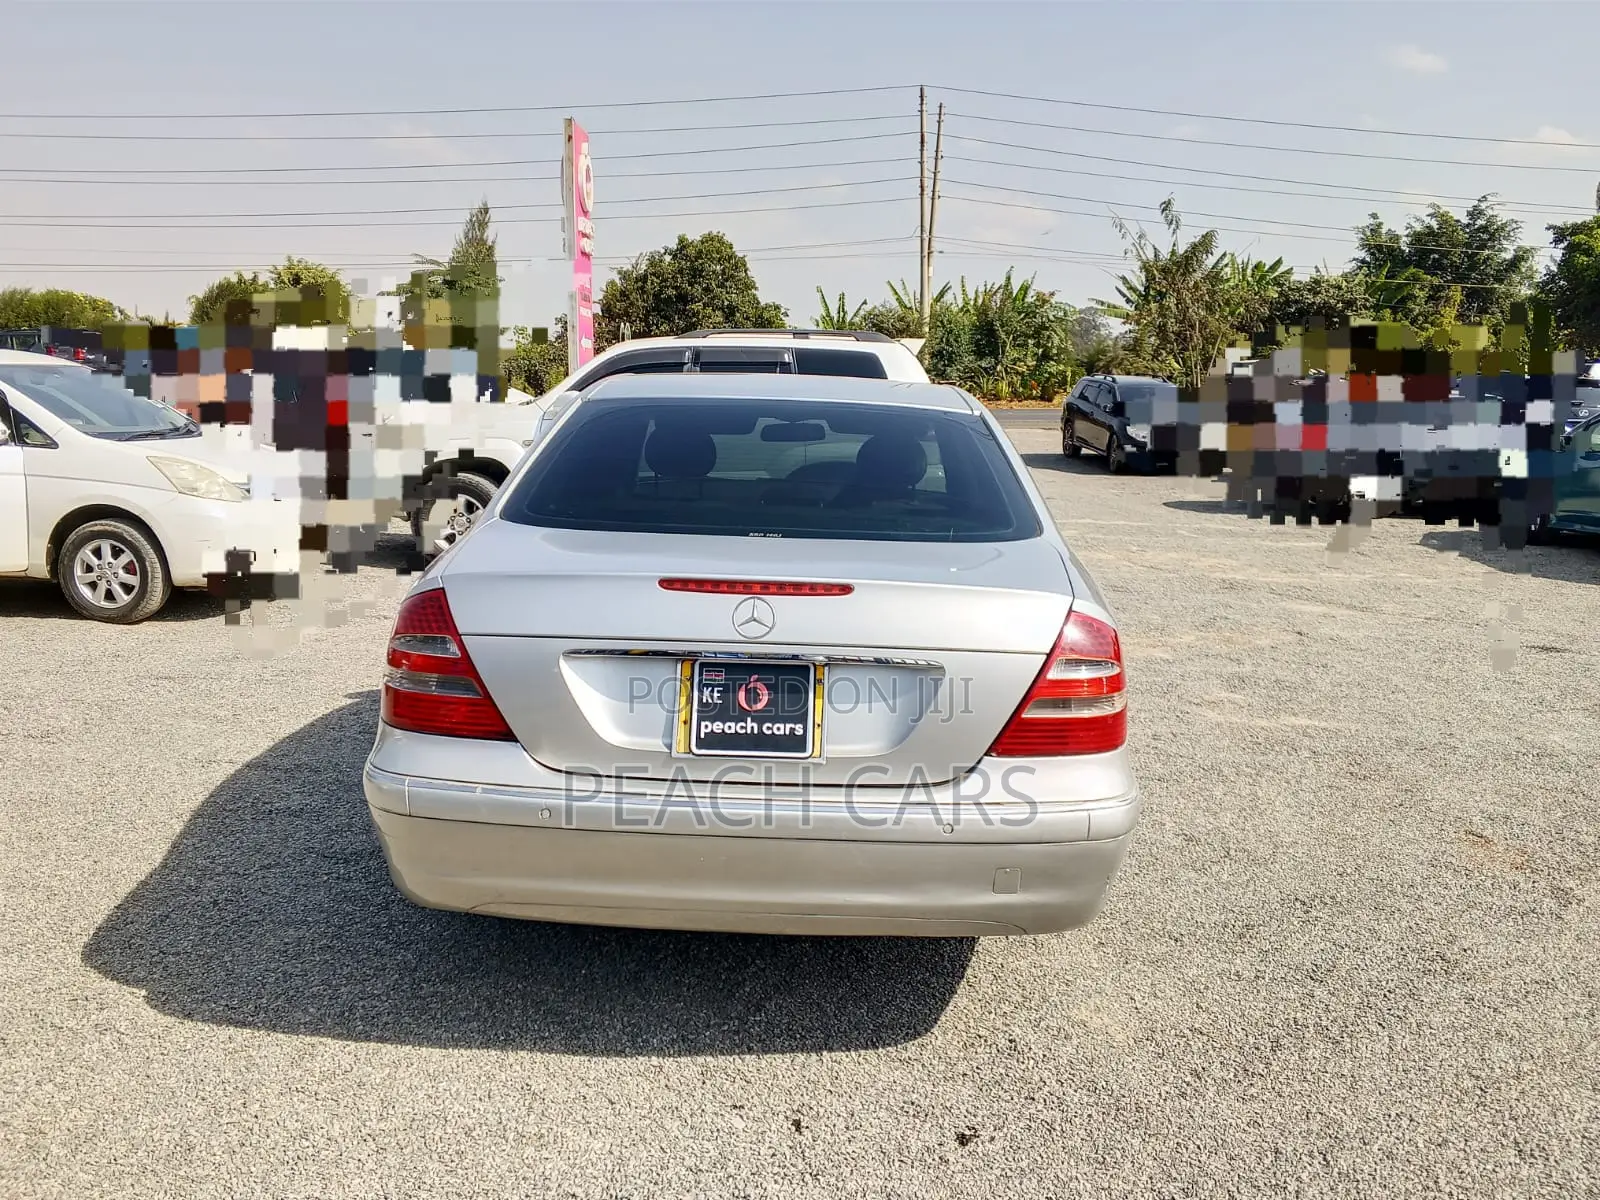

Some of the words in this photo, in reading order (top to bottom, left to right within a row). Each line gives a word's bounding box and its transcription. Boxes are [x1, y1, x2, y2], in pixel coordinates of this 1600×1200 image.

[702, 687, 724, 704] KE
[700, 717, 758, 739] peach
[762, 722, 804, 736] cars
